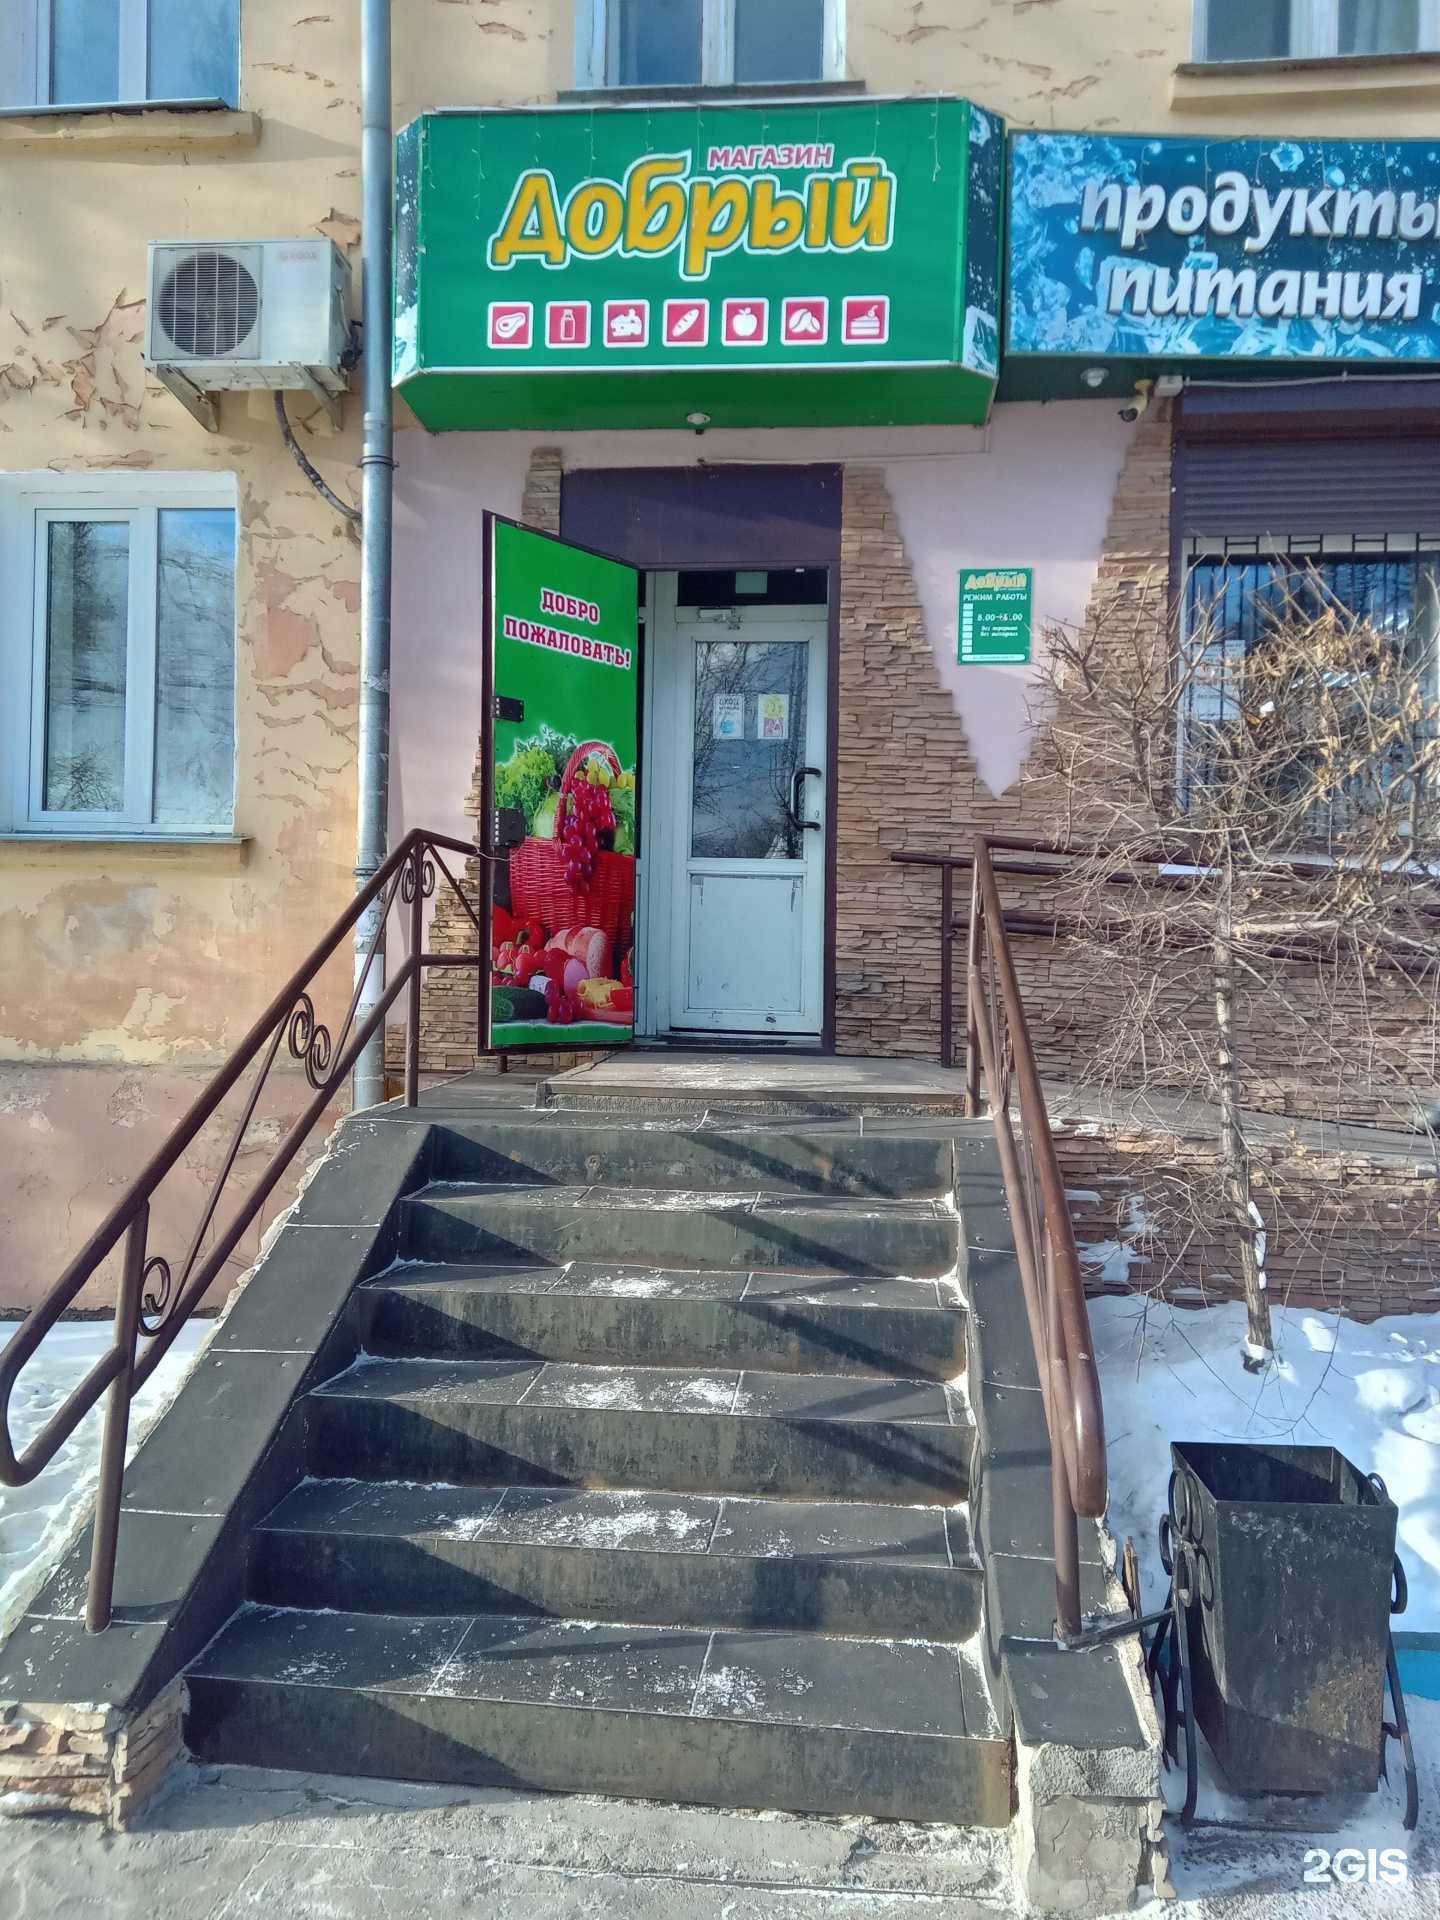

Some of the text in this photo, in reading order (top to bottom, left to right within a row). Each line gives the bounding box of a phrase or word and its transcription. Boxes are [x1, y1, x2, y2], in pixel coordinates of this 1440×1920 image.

[707, 143, 835, 171] МАГАЗИН
[487, 150, 897, 281] Добрый
[1081, 171, 1440, 253] продукты
[1107, 264, 1423, 320] питания
[541, 587, 600, 625] ДОБРО
[963, 593, 1028, 601] РЕЖИМ РАБОТЫ
[504, 615, 632, 670] ПОЖАЛОВАТЬ!
